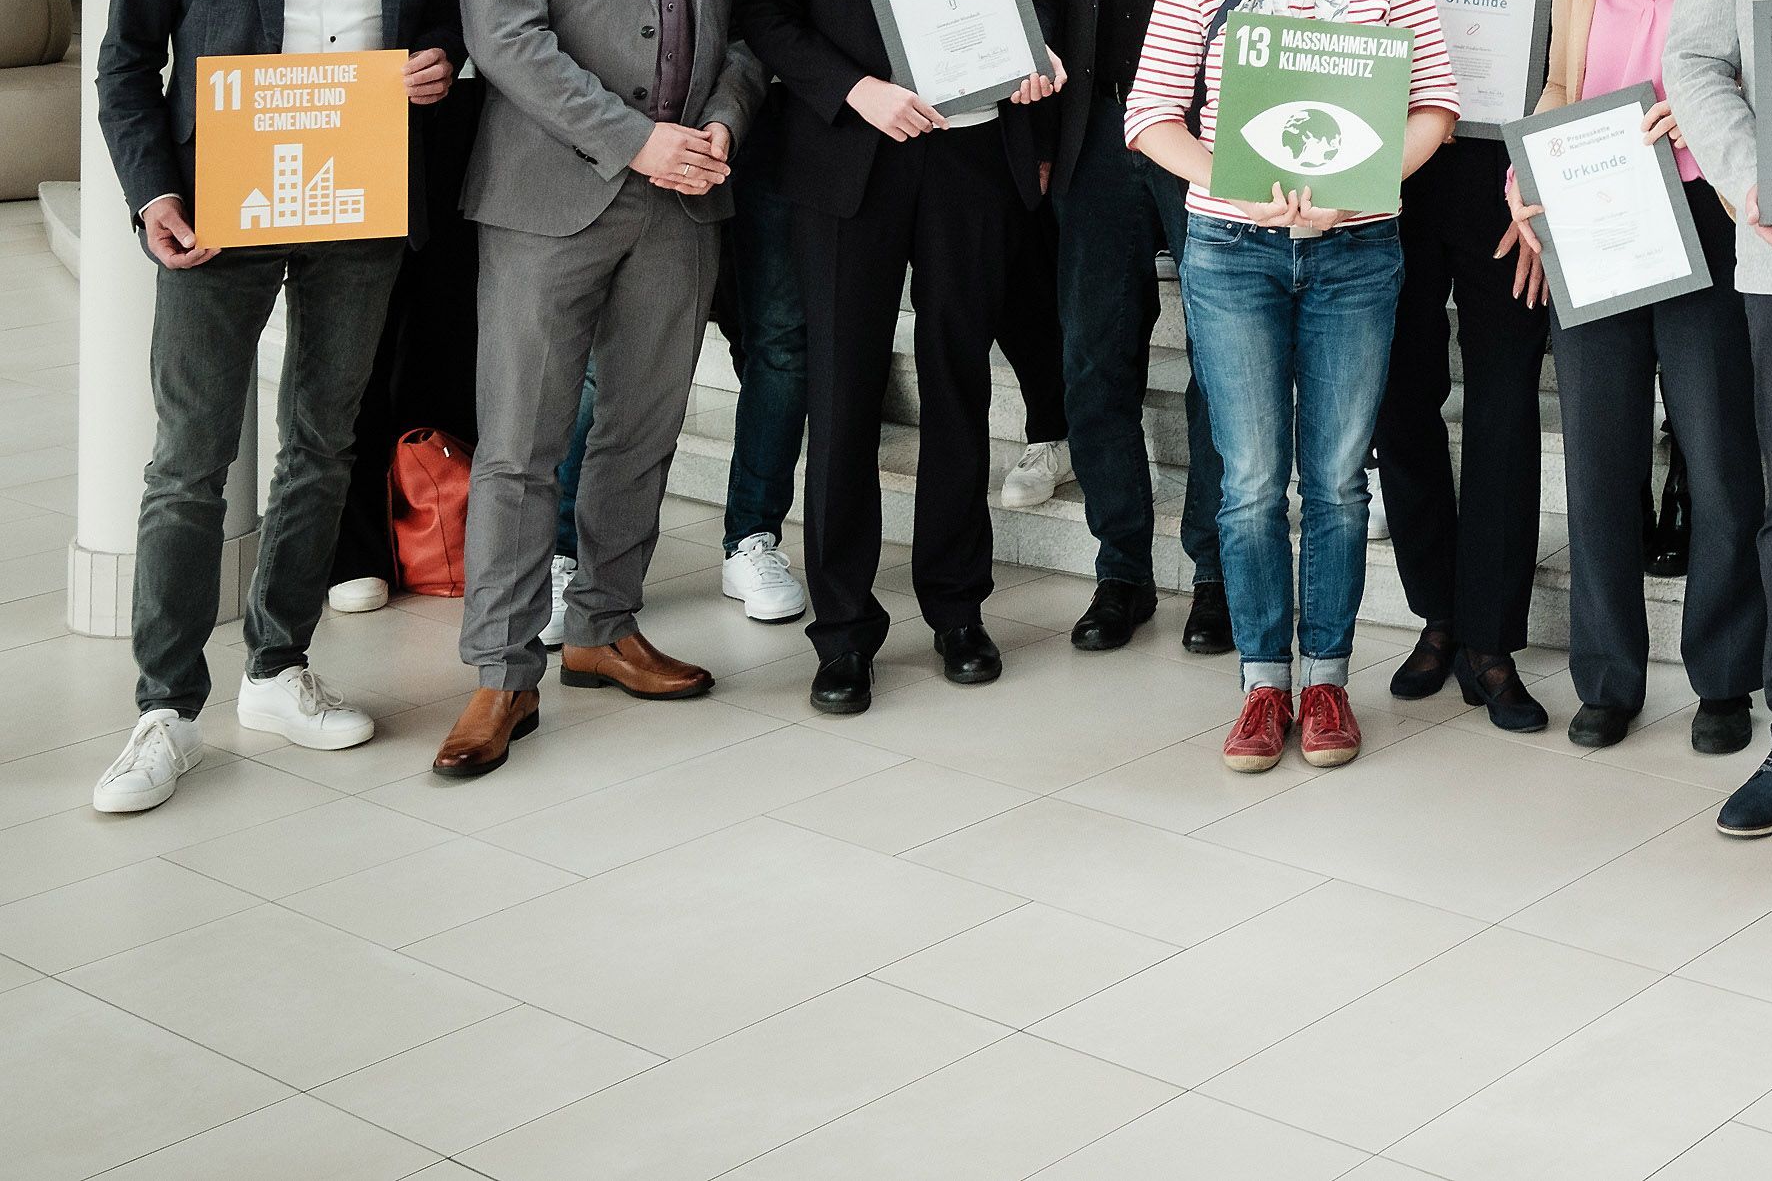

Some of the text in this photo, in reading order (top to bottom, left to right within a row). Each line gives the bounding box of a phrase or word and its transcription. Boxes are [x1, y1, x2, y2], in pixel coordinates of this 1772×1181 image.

[1236, 25, 1271, 68] 13
[1281, 28, 1409, 59] MASSNAHMEN ZUM
[254, 64, 358, 86] NACHHALTIGE
[1278, 51, 1375, 78] KLIMASCHUTZ
[210, 69, 242, 111] 11
[254, 87, 346, 109] STÄDTE UND
[254, 110, 341, 132] GEMEINDEN
[1562, 155, 1628, 181] Urkunde
